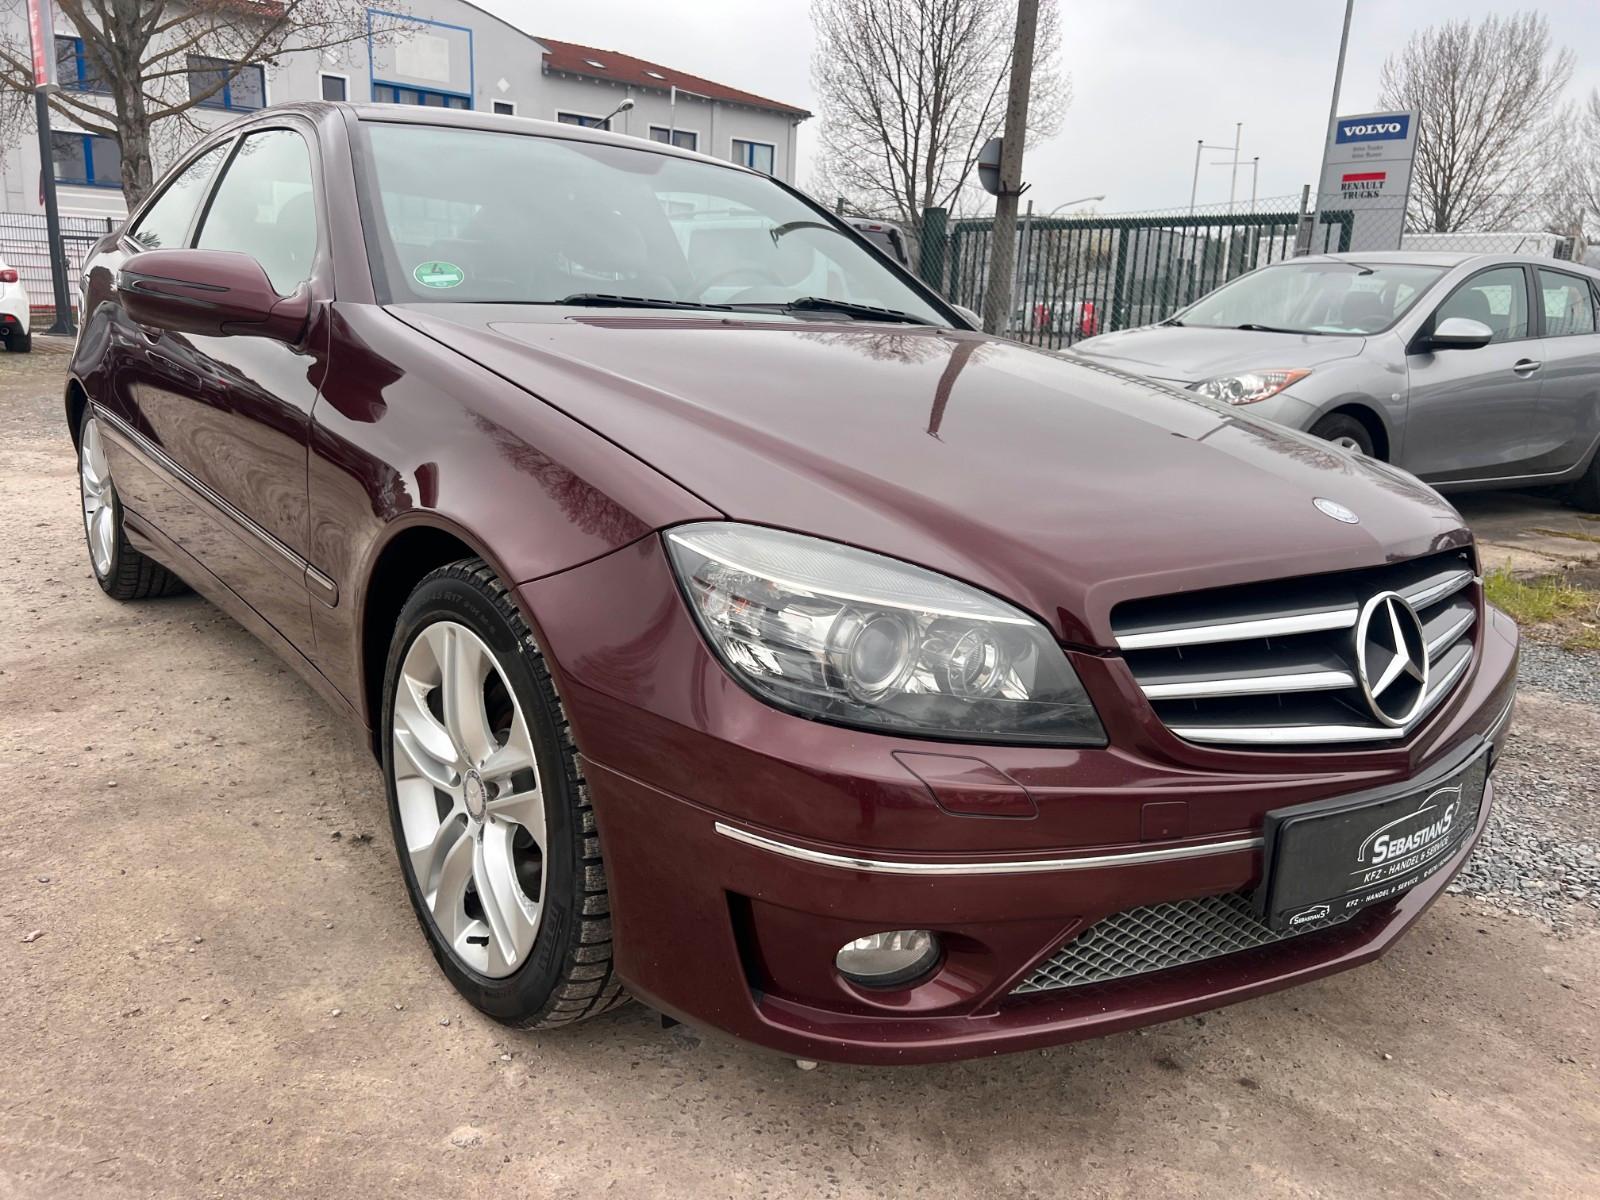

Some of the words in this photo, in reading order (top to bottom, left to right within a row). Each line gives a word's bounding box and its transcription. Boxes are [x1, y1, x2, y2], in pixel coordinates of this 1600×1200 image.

[1344, 123, 1401, 136] VOLVO
[1341, 181, 1385, 191] RENAULT
[1343, 190, 1380, 200] TRUCKS
[1364, 868, 1381, 883] KFZ
[1389, 855, 1419, 875] HANDEL
[1426, 836, 1449, 857] SERVICE
[1346, 898, 1359, 908] KFZ
[1366, 889, 1390, 902] HANDEL
[1397, 876, 1418, 891] SERVICE
